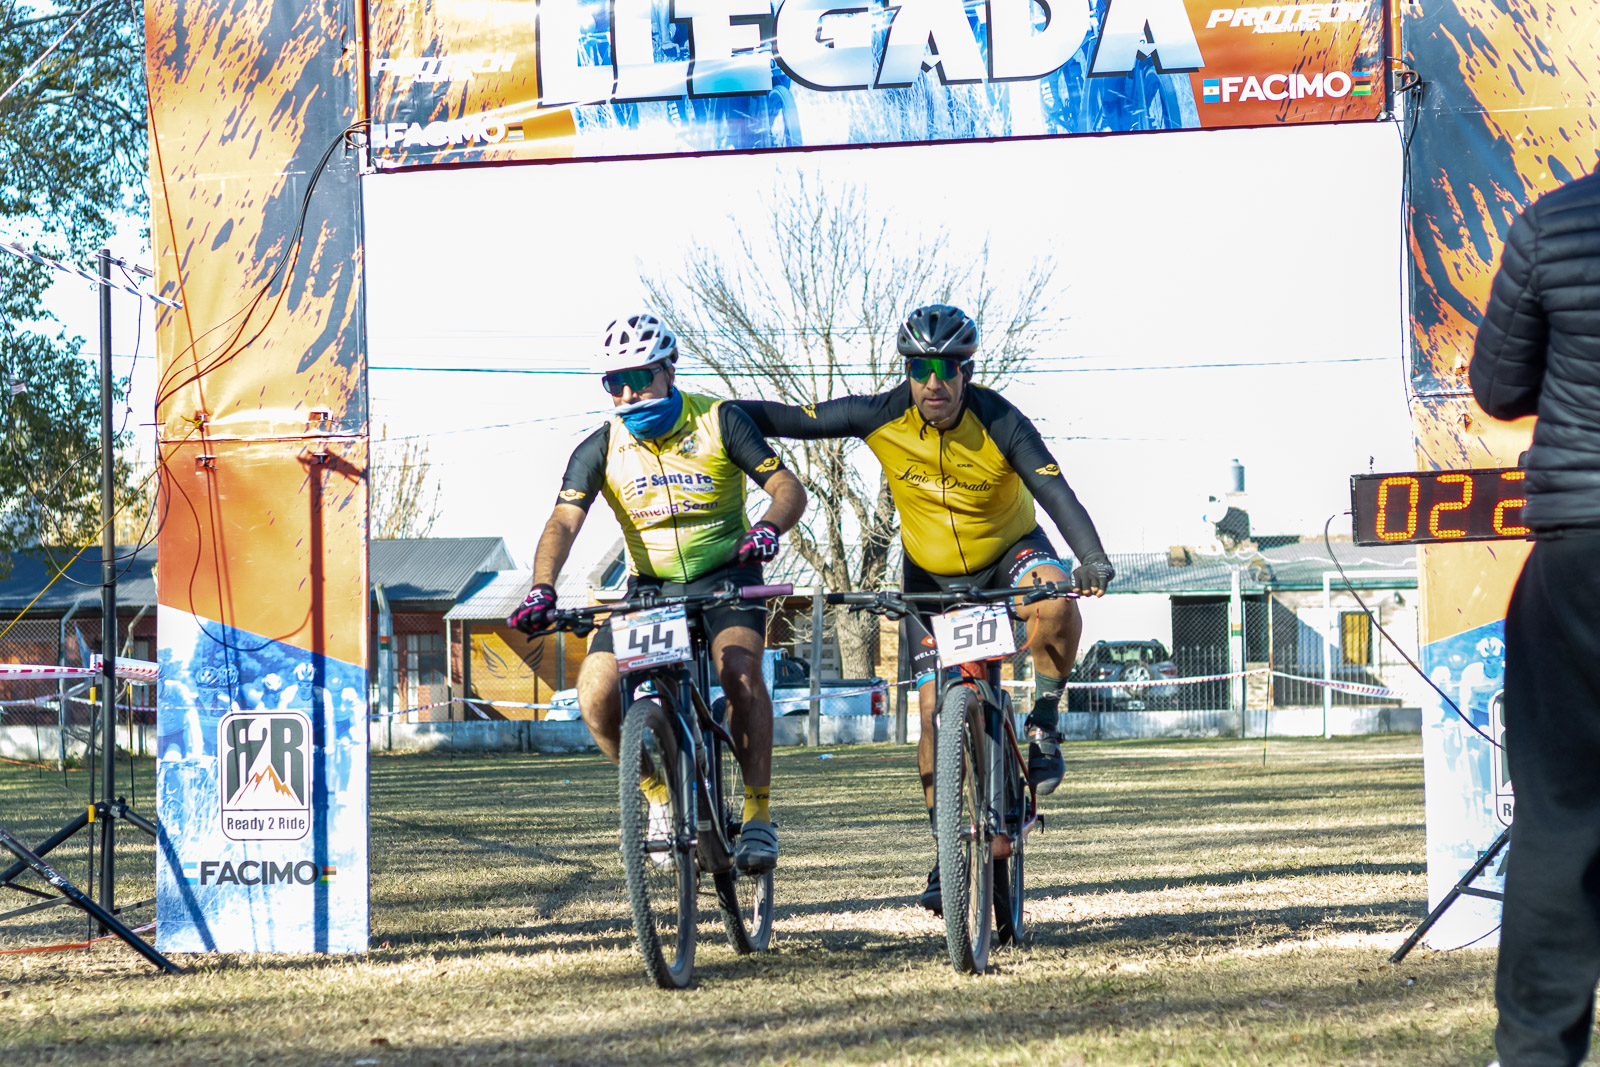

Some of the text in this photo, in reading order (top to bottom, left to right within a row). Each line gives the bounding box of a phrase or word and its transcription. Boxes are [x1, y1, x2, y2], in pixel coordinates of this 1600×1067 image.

[1222, 71, 1351, 103] FACIMO
[651, 473, 713, 486] Santa Fe
[683, 500, 718, 512] Senn
[628, 624, 674, 653] 44
[953, 618, 998, 650] 50
[227, 817, 305, 831] Ready 2 Ride
[200, 860, 318, 886] FACIMO
